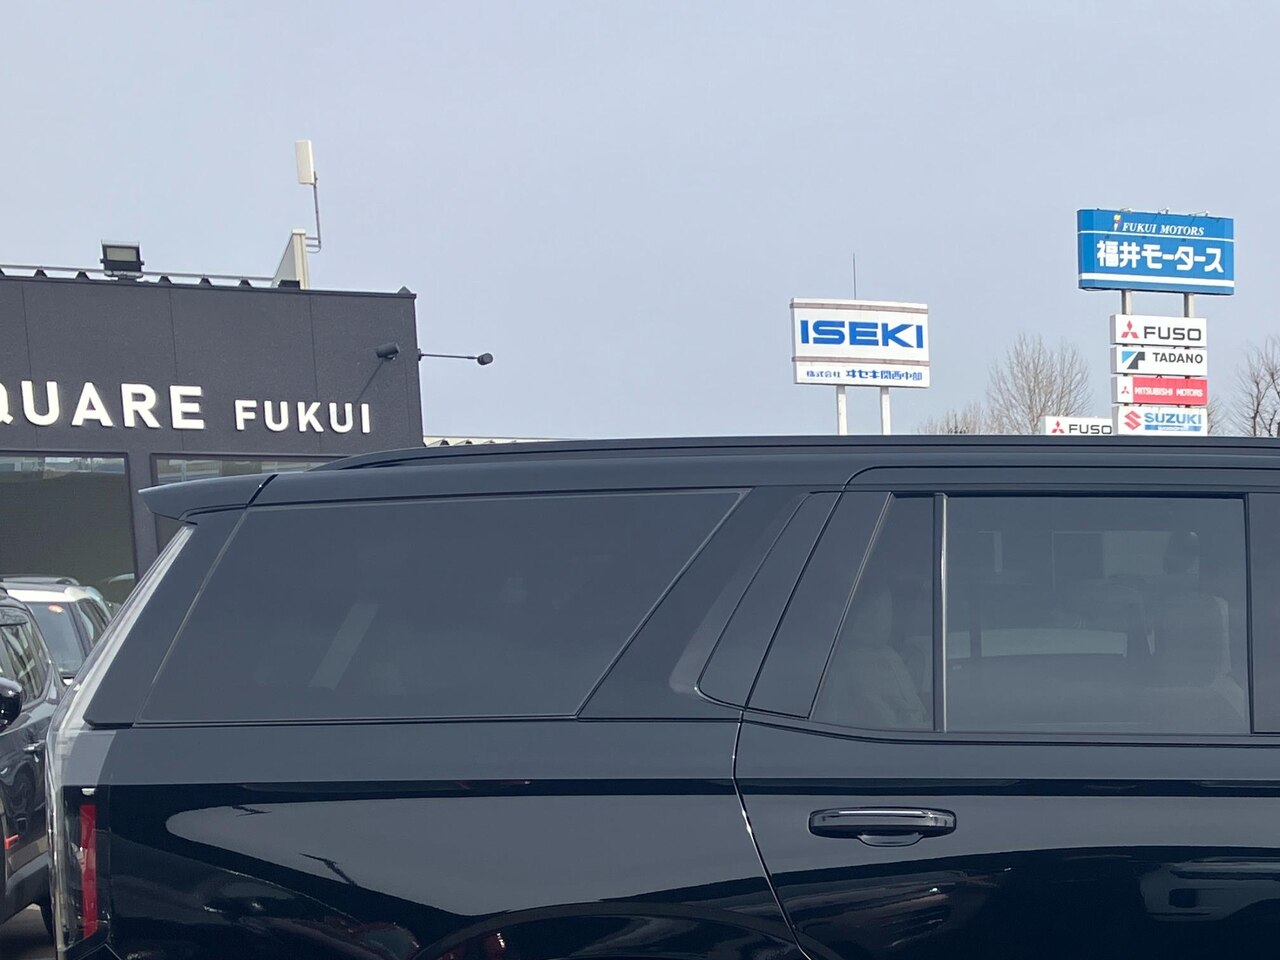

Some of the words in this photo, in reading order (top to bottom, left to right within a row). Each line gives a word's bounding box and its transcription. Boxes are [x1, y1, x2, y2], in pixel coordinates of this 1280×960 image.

[1122, 222, 1157, 234] FUKUI
[1160, 224, 1205, 236] MOTORS
[1096, 240, 1225, 273] 福井モータース
[800, 319, 924, 349] ISEKI
[1143, 326, 1202, 341] FUSO
[1152, 352, 1204, 364] TADANO
[1134, 387, 1173, 396] MITSUBISHI
[1176, 388, 1203, 397] MOTORS
[235, 400, 371, 433] FUKUI
[1144, 412, 1202, 425] SUZUKI
[1068, 424, 1112, 435] FUSO
